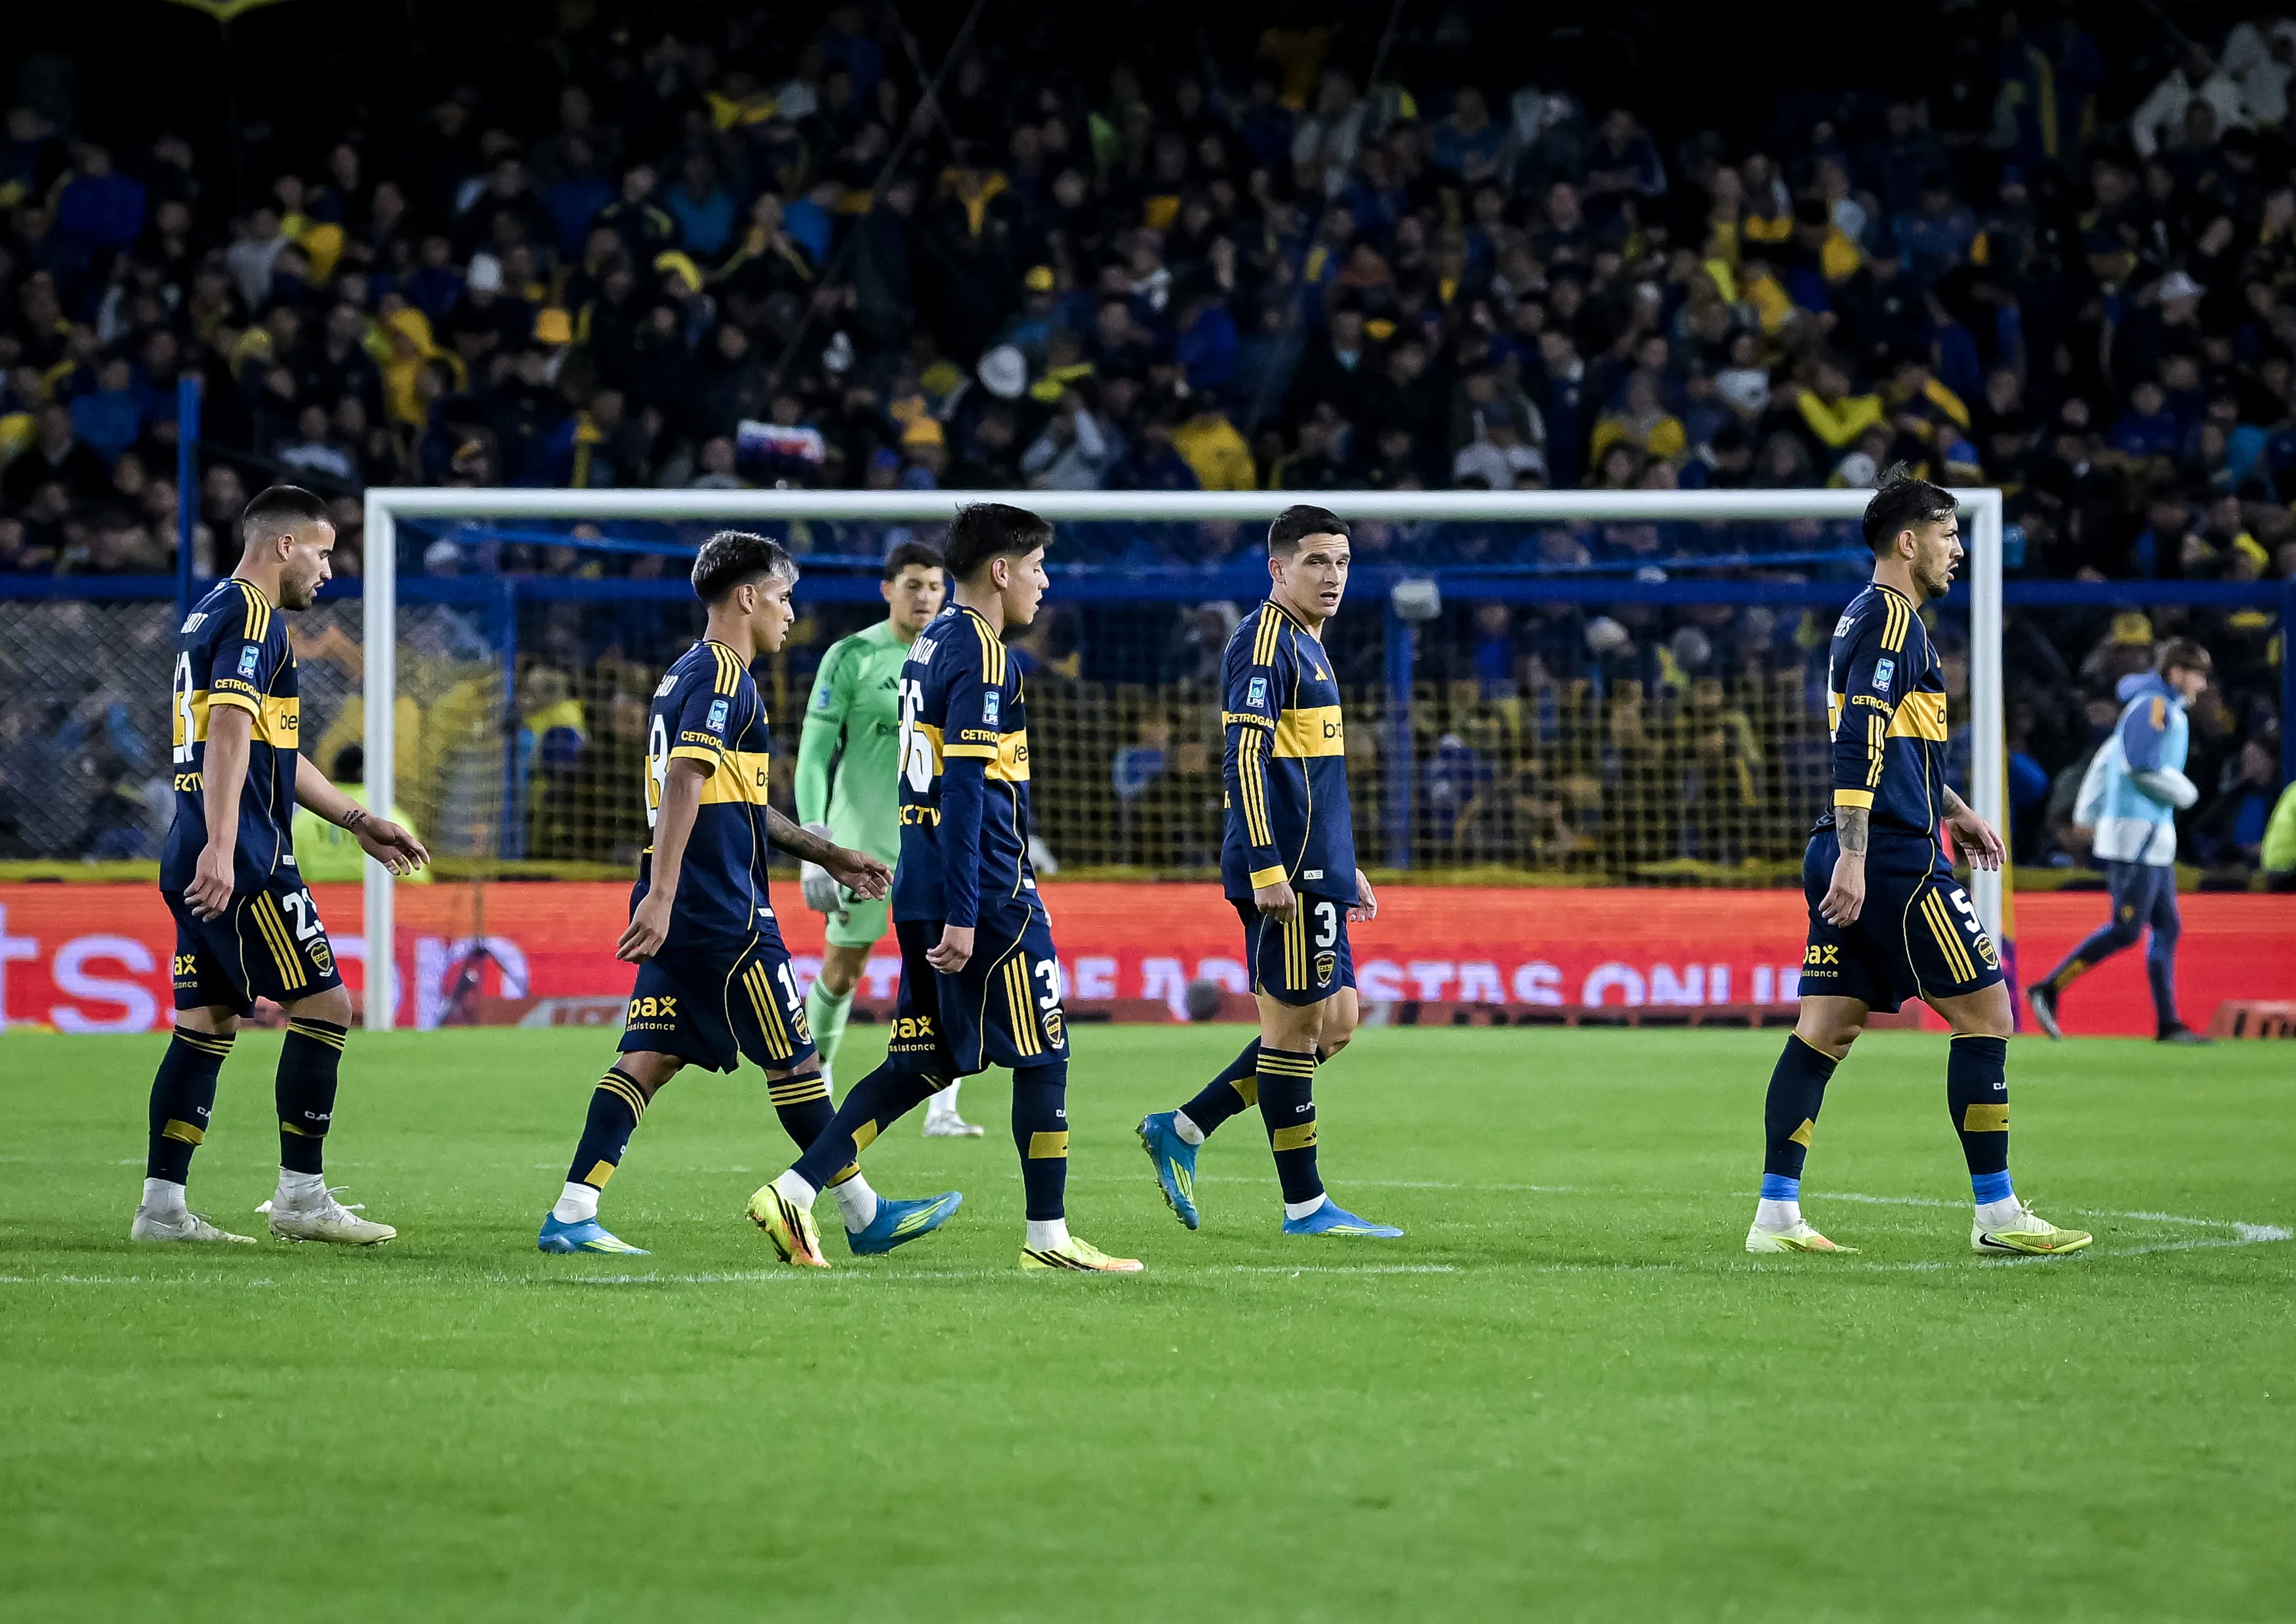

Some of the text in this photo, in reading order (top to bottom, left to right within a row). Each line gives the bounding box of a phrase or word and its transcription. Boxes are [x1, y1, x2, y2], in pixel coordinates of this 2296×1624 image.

[239, 666, 254, 676] LPF
[1874, 680, 1889, 689] LPF
[1248, 698, 1263, 706] LPF
[707, 720, 724, 731] LPF
[1227, 714, 1275, 729] CETROGAR
[1950, 888, 1981, 933] 5
[1315, 902, 1337, 947] 3
[628, 996, 677, 1025] pax
